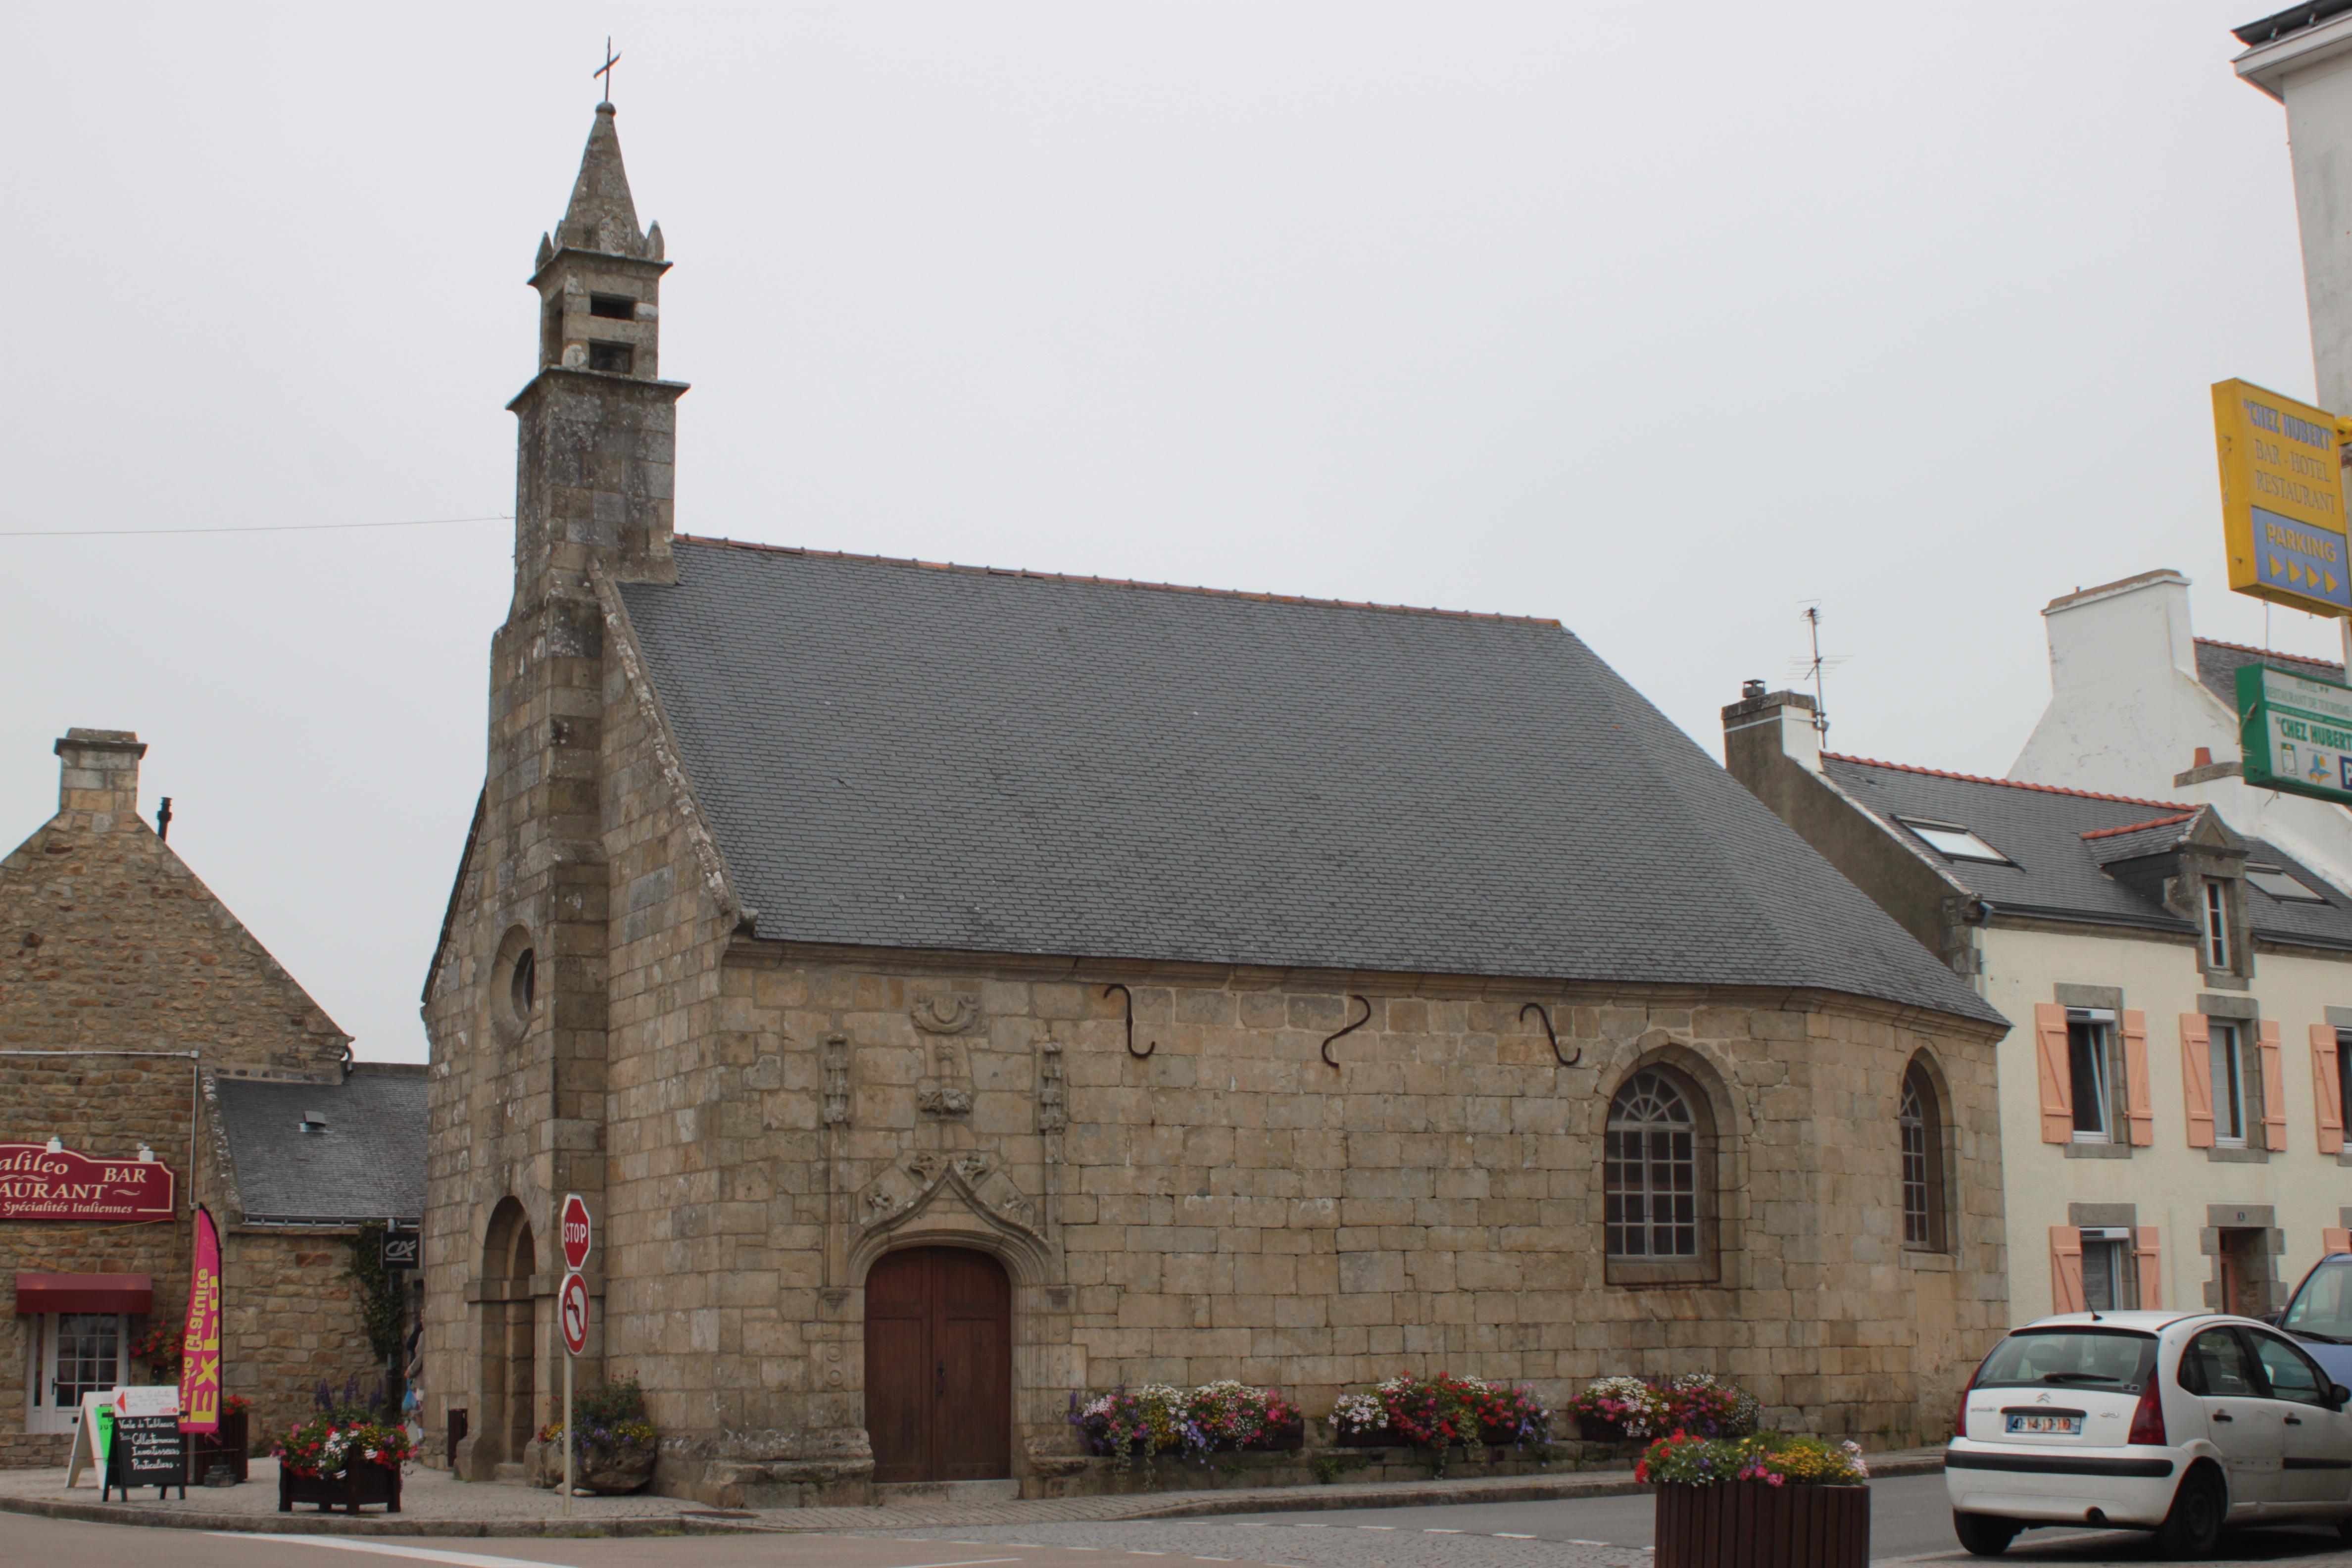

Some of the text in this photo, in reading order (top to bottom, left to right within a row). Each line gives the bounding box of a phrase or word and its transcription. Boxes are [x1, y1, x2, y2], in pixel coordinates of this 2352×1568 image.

[2254, 439, 2281, 466] BAR
[2290, 451, 2331, 483] HOTEL
[2254, 469, 2335, 515] RESTAURANT
[2265, 522, 2337, 563] PARKING
[102, 1167, 147, 1183] BAR
[2, 1200, 133, 1216] Spécialités Italiennes
[564, 1223, 587, 1244] STOP
